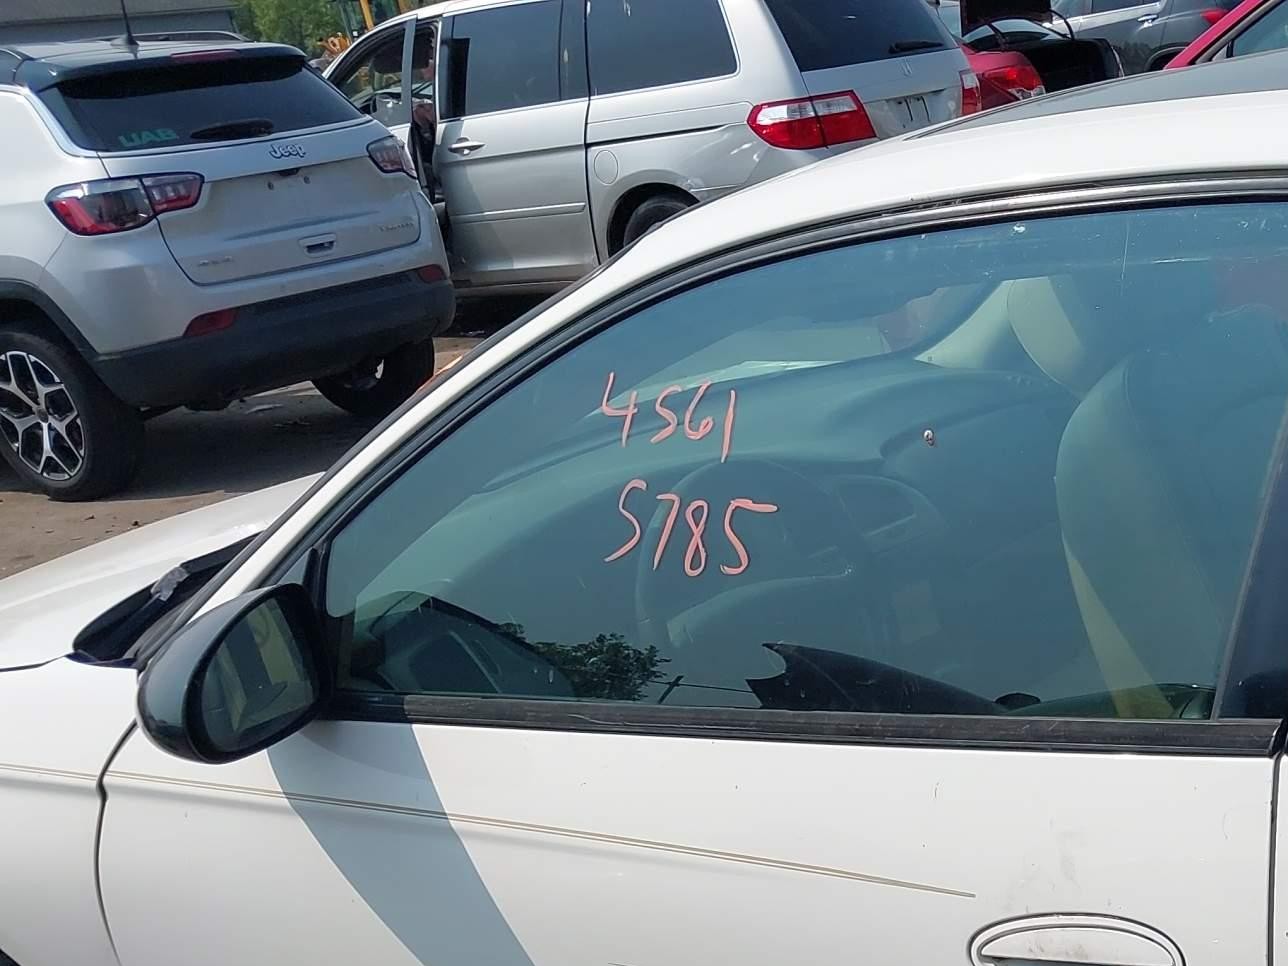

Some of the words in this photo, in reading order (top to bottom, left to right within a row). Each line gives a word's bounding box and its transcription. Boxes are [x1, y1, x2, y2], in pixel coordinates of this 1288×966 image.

[269, 143, 306, 159] Jeep
[601, 371, 736, 463] 4561
[604, 479, 778, 577] 5785
